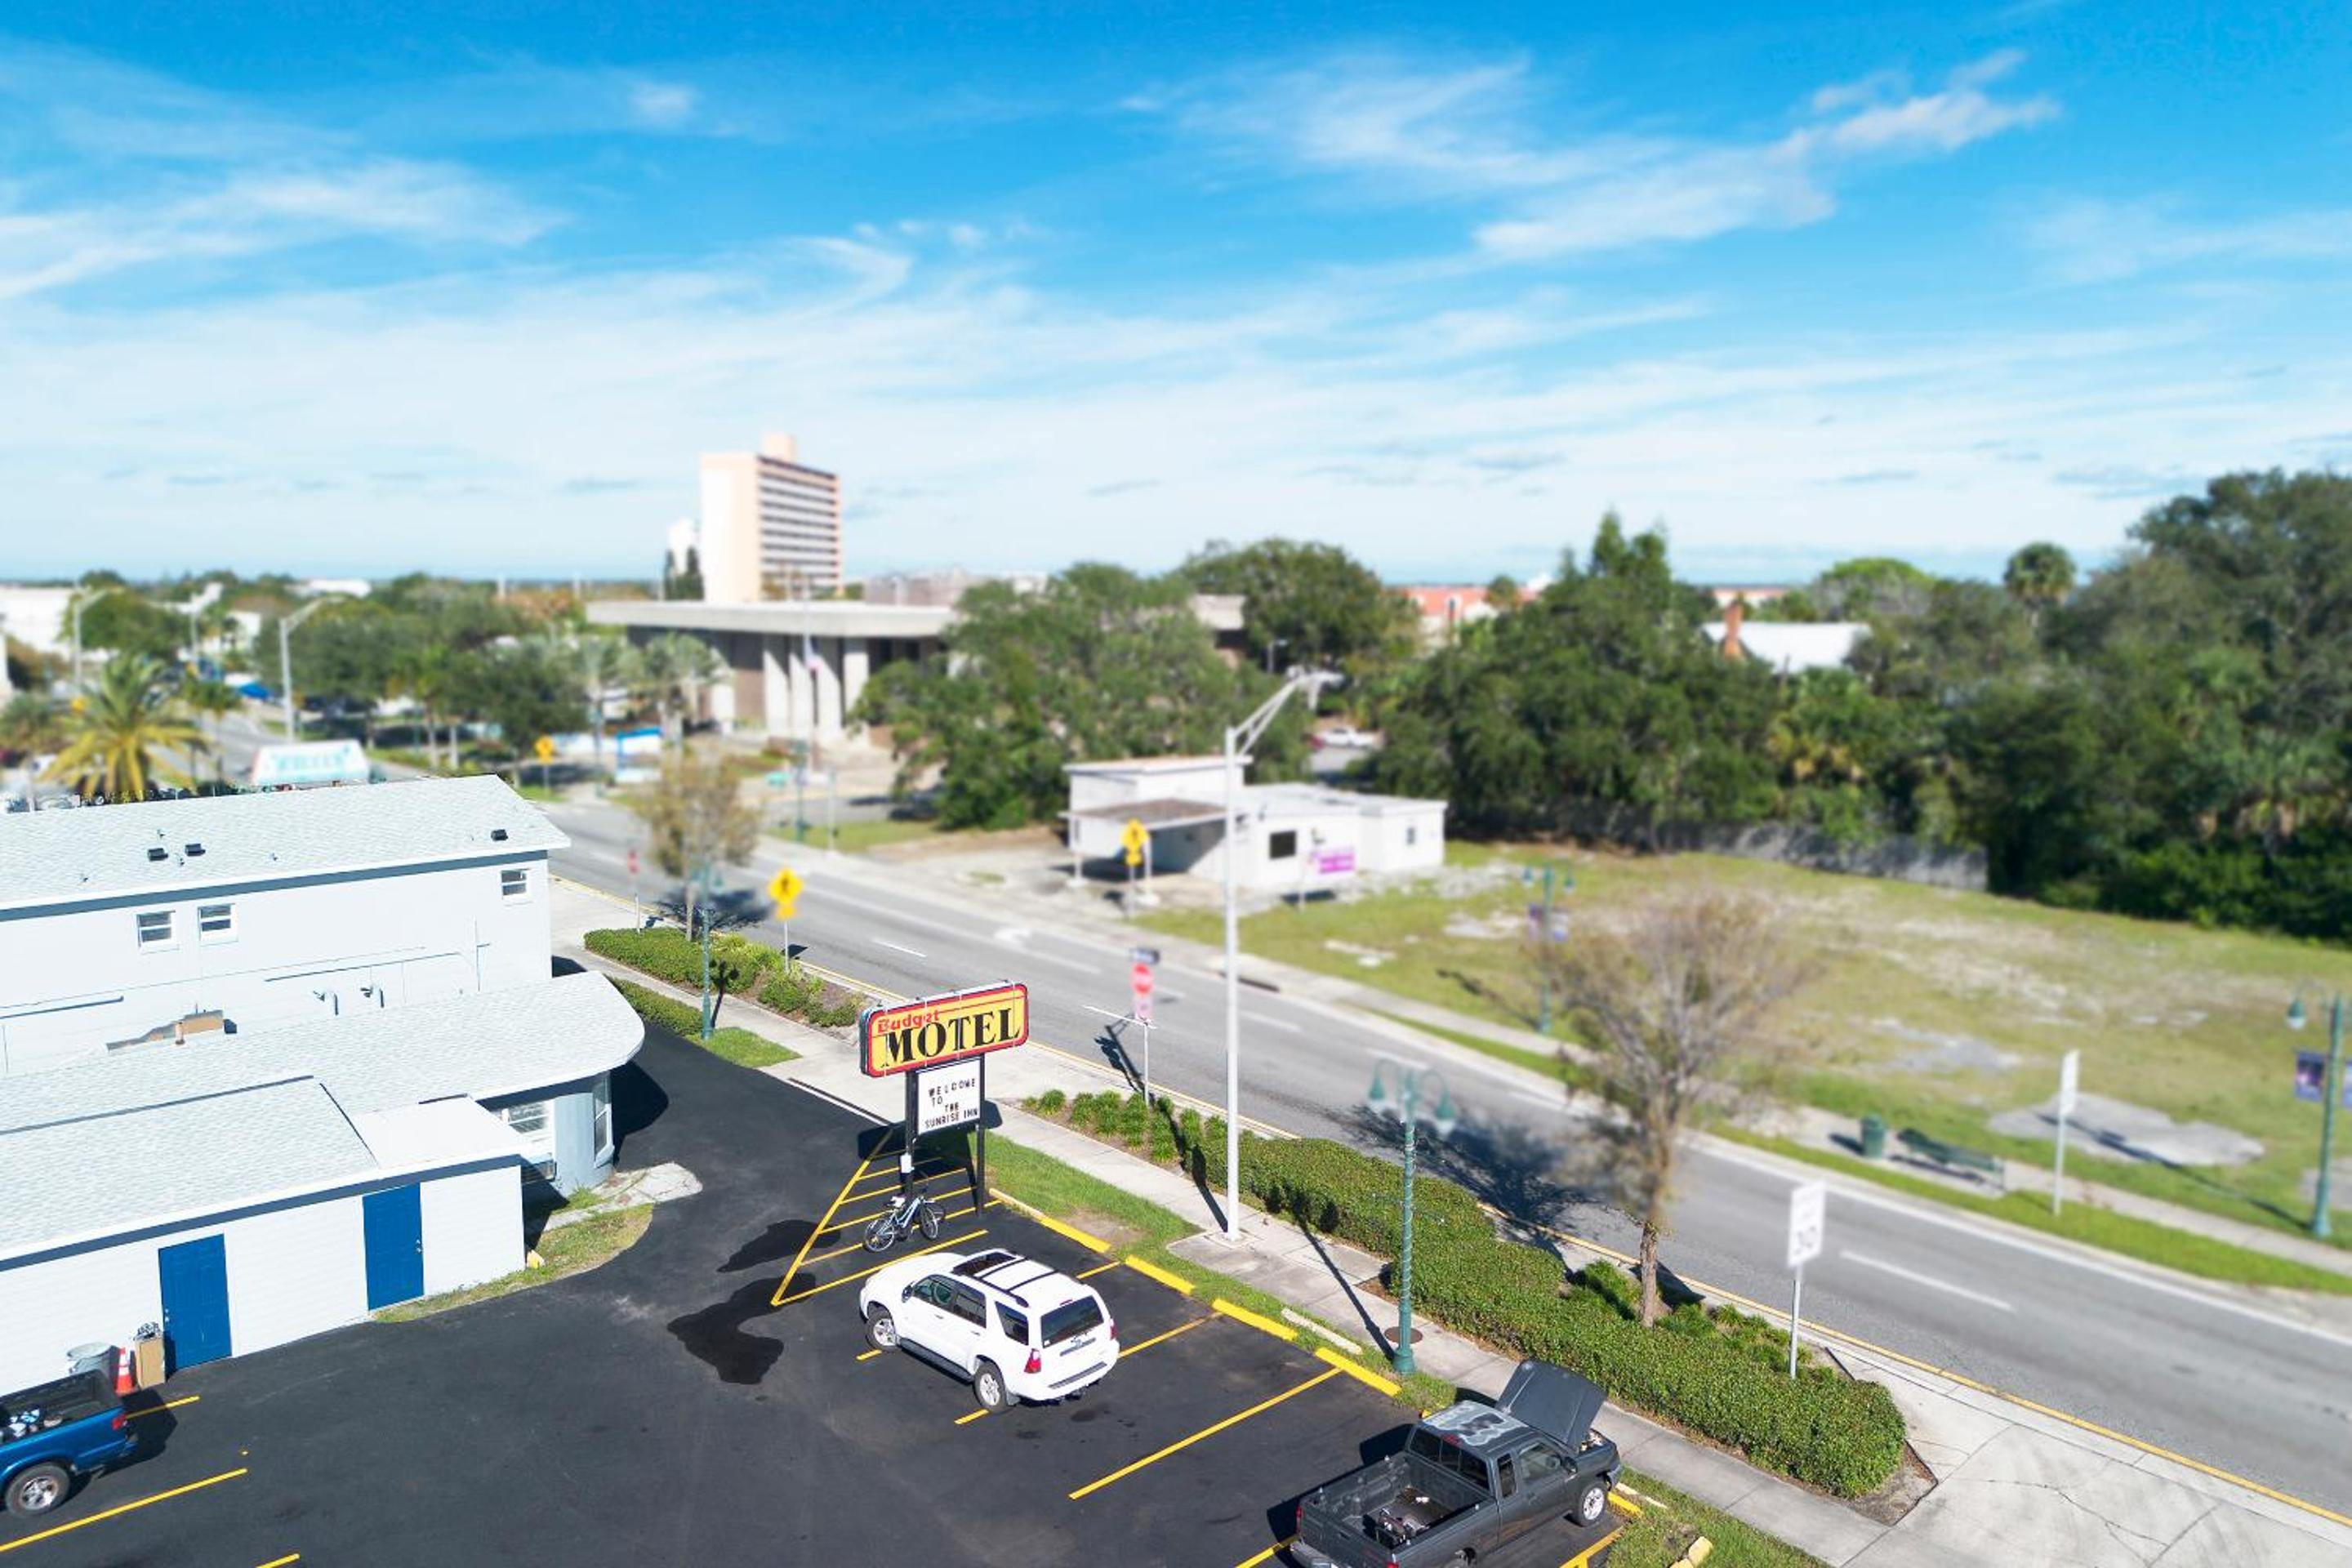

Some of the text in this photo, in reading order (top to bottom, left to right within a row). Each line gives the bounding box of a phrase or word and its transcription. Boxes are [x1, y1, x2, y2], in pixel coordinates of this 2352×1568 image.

[878, 1009, 939, 1032] Budget
[880, 1009, 1020, 1067] MOTEL
[929, 1078, 976, 1097] WELCOME
[932, 1096, 942, 1107] TO
[945, 1102, 959, 1111] THE
[925, 1107, 978, 1128] SUNRISE INN
